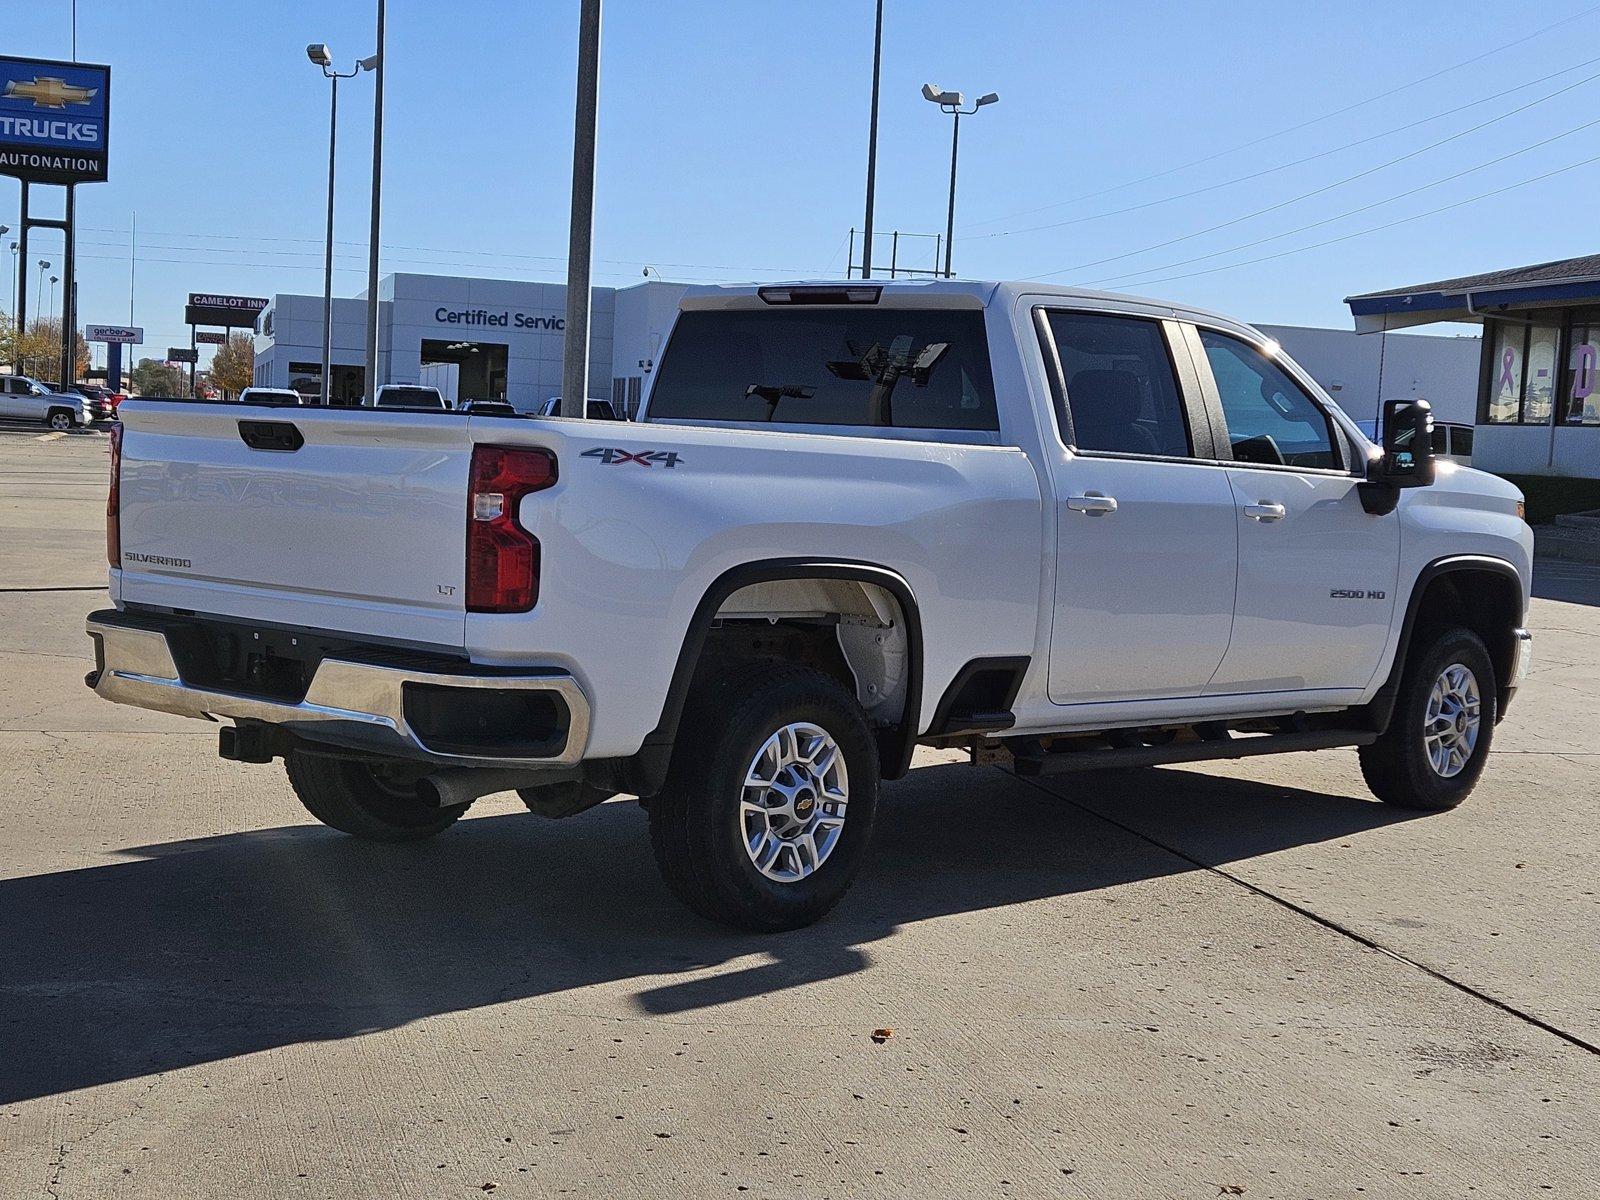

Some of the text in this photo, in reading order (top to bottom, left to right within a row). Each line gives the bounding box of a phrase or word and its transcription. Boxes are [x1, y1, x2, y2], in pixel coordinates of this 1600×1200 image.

[0, 117, 98, 141] TRUCKS
[0, 153, 98, 171] AUTONATION
[193, 296, 266, 308] CAMELOT INN
[435, 307, 565, 330] Certified Servic
[93, 328, 126, 336] gerber
[124, 552, 191, 568] SILVERADO
[436, 584, 456, 596] LT
[1330, 589, 1386, 600] 2500 HD
